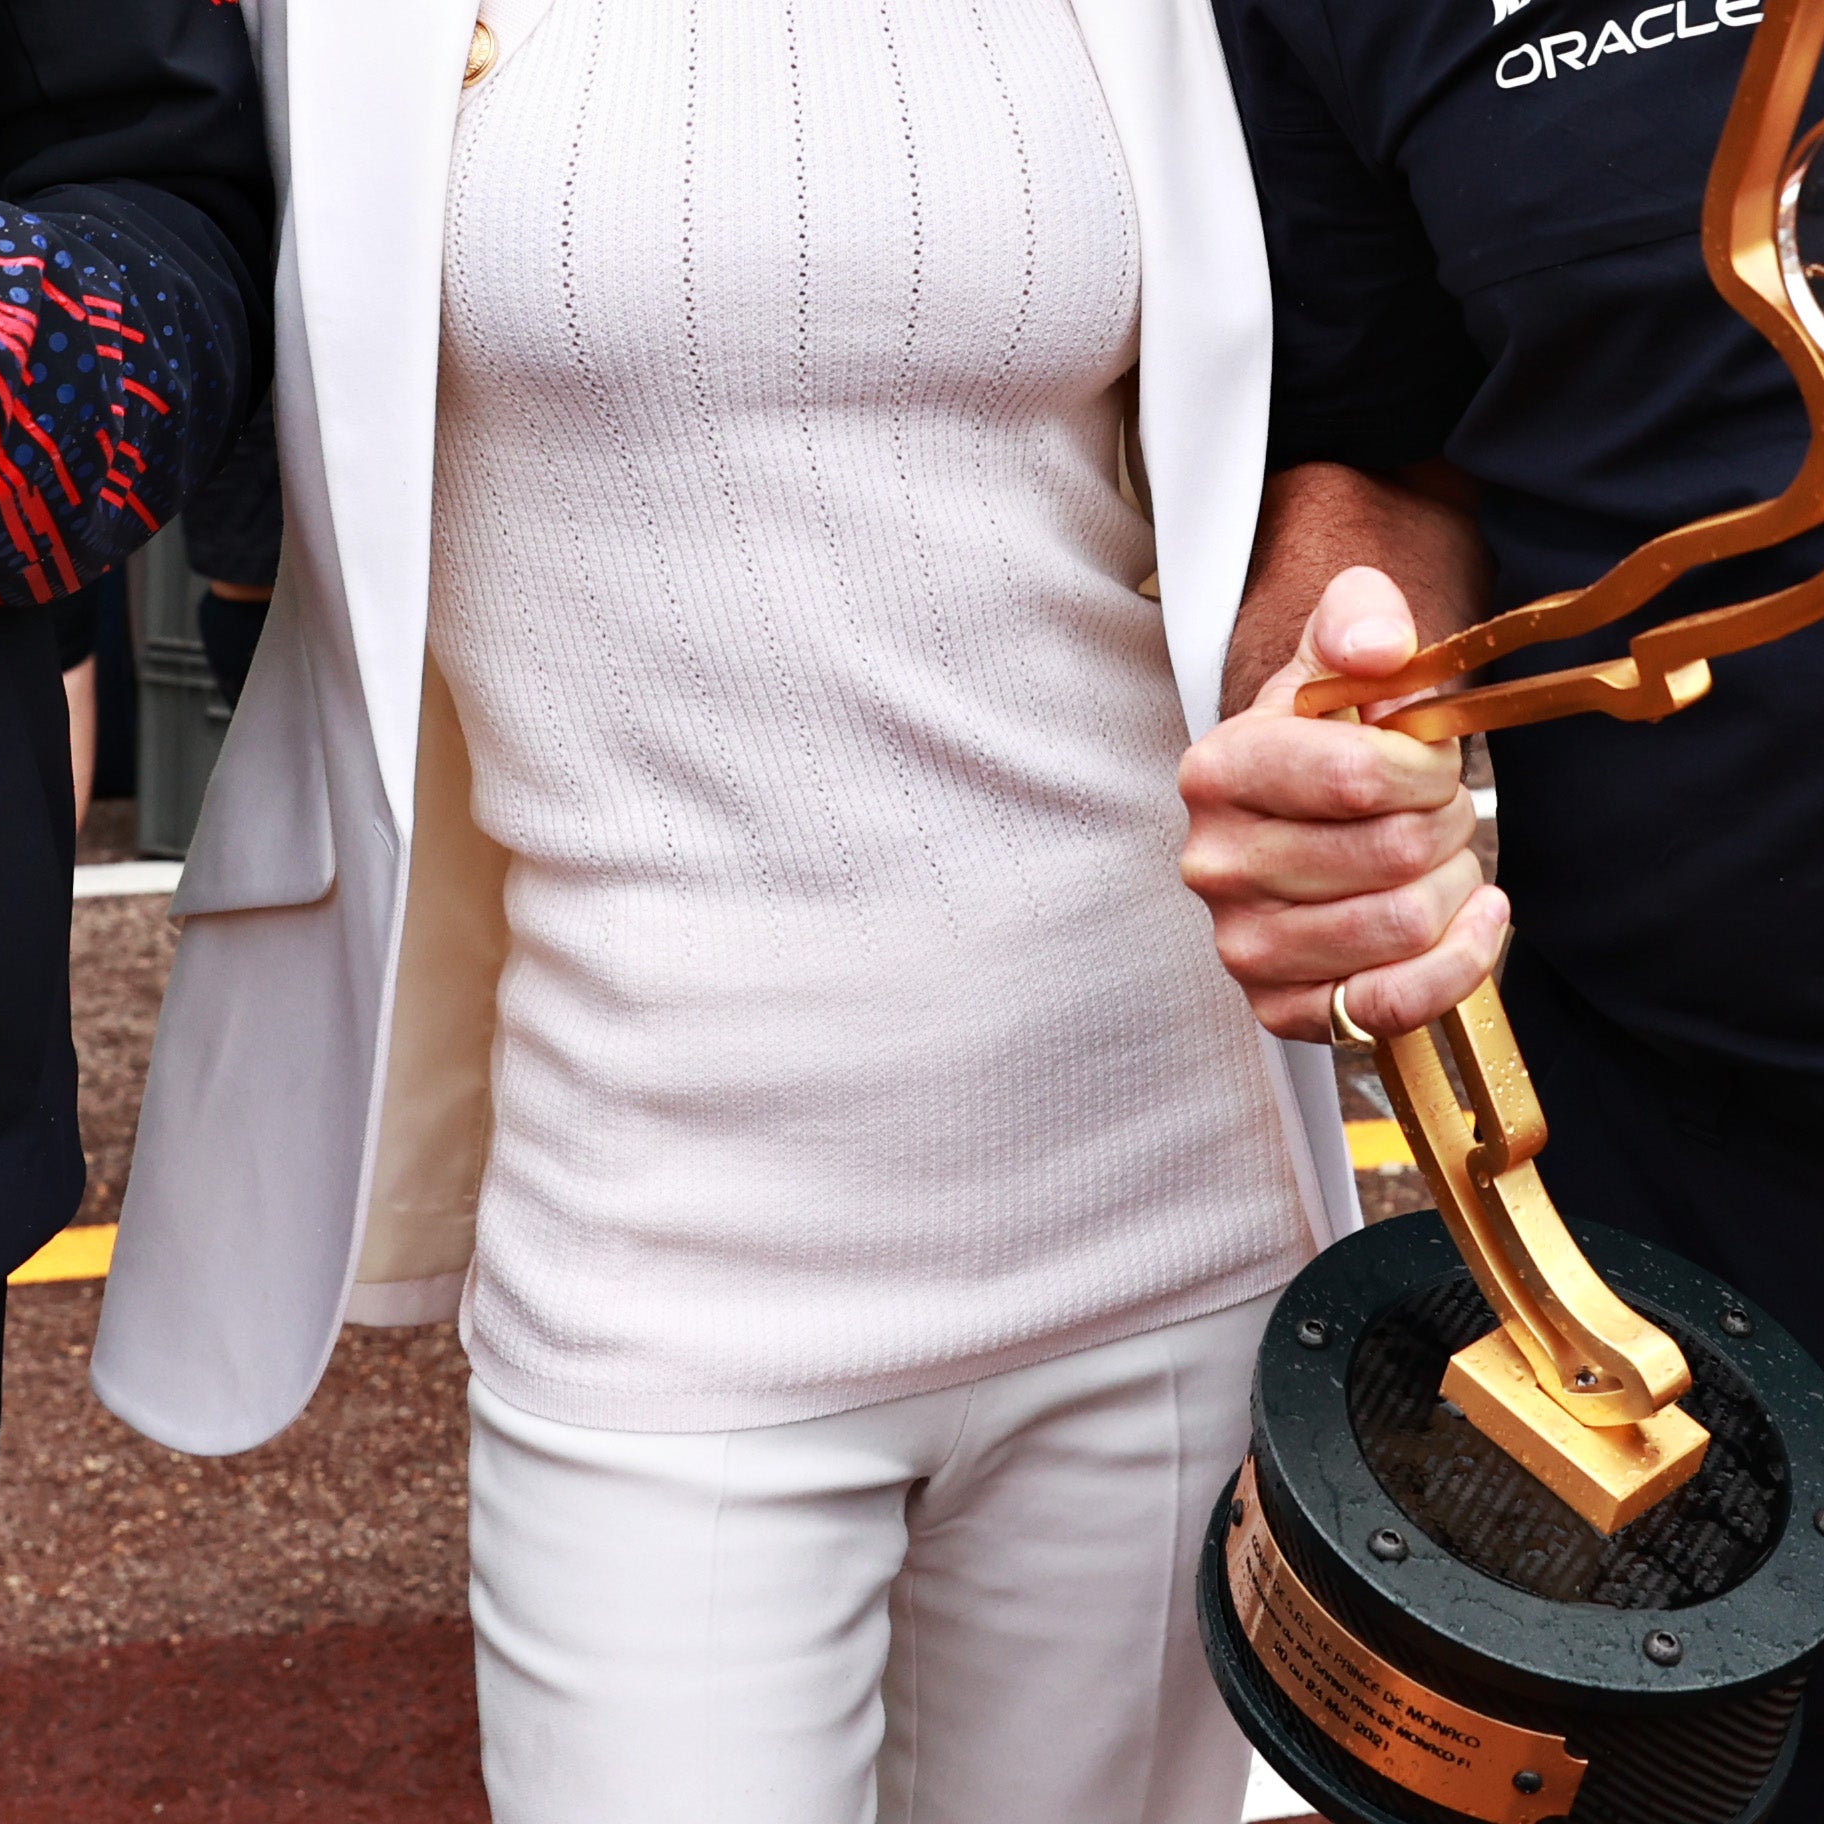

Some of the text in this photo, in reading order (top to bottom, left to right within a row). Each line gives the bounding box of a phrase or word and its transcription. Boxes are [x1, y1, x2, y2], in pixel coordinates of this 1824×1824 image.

[1333, 1652, 1381, 1696] PRINCE
[1382, 1689, 1405, 1712] DE
[1406, 1704, 1482, 1749] MONACO
[1352, 1719, 1391, 1753] 2021
[1376, 1713, 1396, 1733] DE
[1395, 1725, 1456, 1763] MONACO
